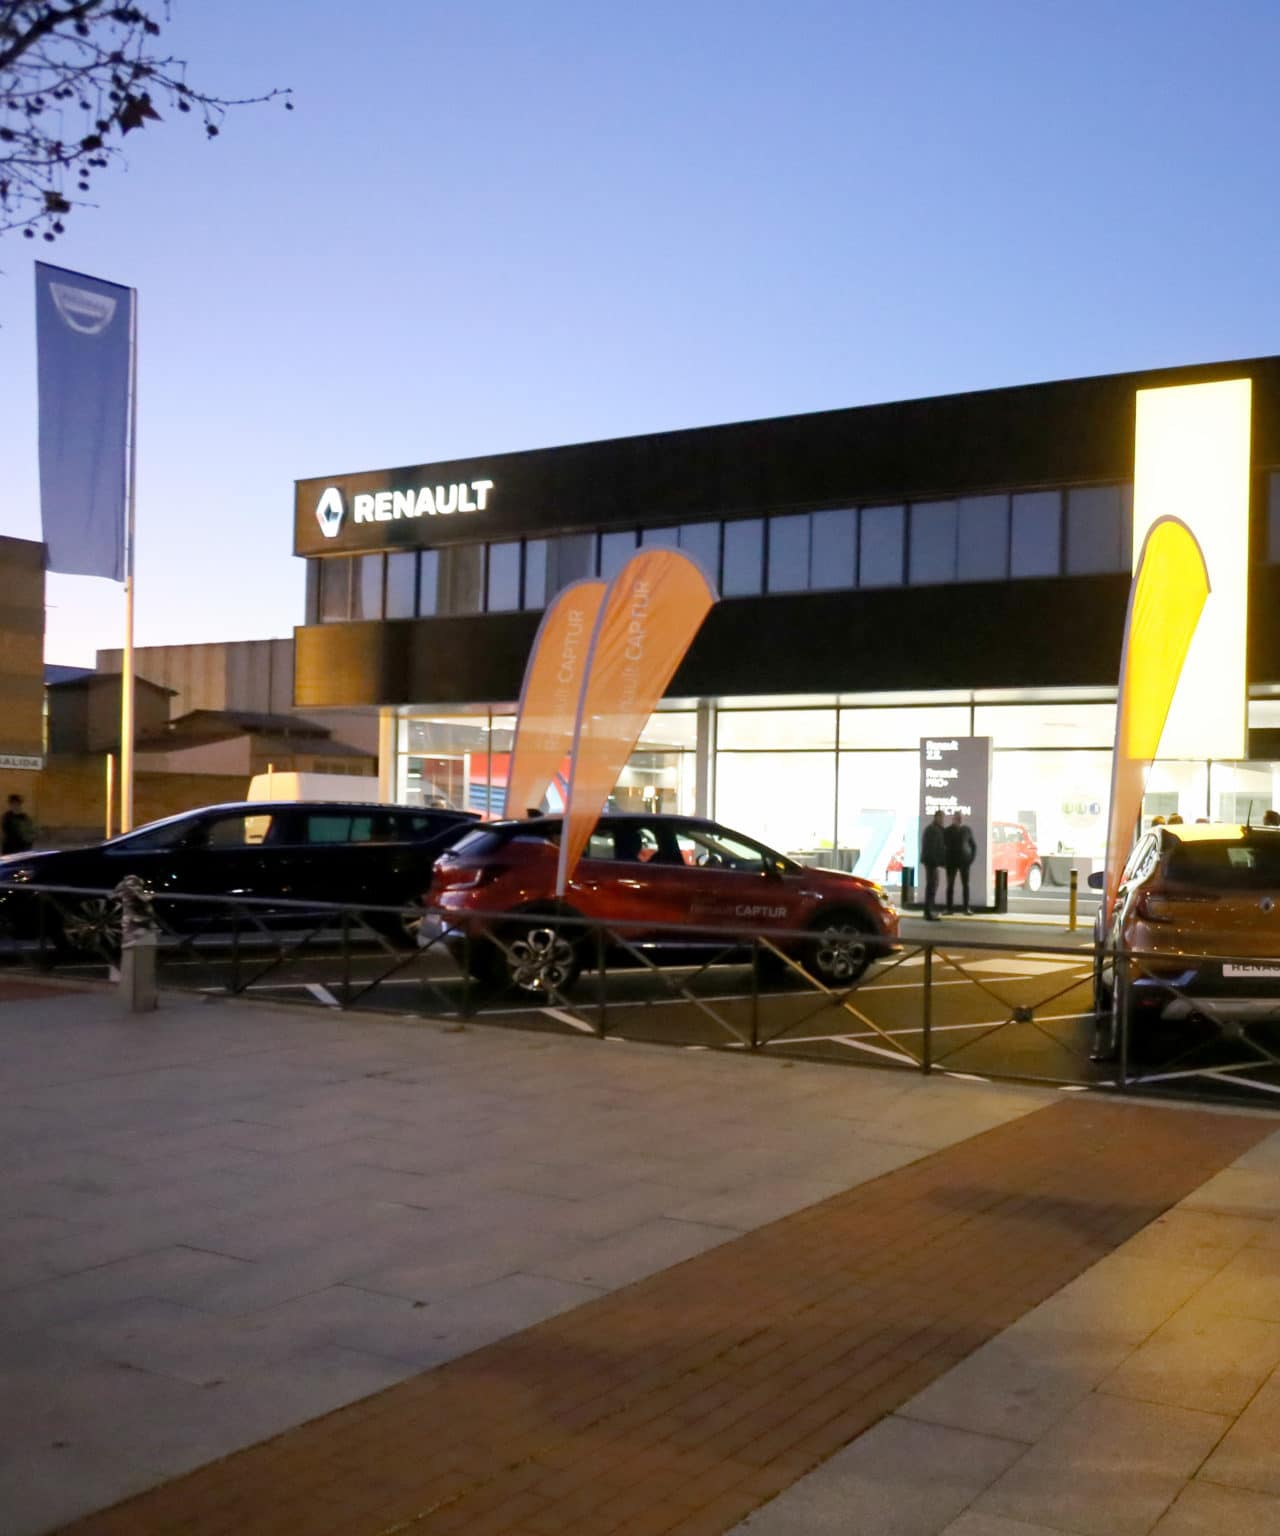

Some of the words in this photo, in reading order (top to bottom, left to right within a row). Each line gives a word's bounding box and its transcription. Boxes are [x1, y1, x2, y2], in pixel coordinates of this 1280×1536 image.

[354, 480, 493, 523] RENAULT
[557, 610, 585, 683] CAPTUR
[624, 581, 650, 661] CAPTUR
[735, 904, 787, 918] CAPTUR
